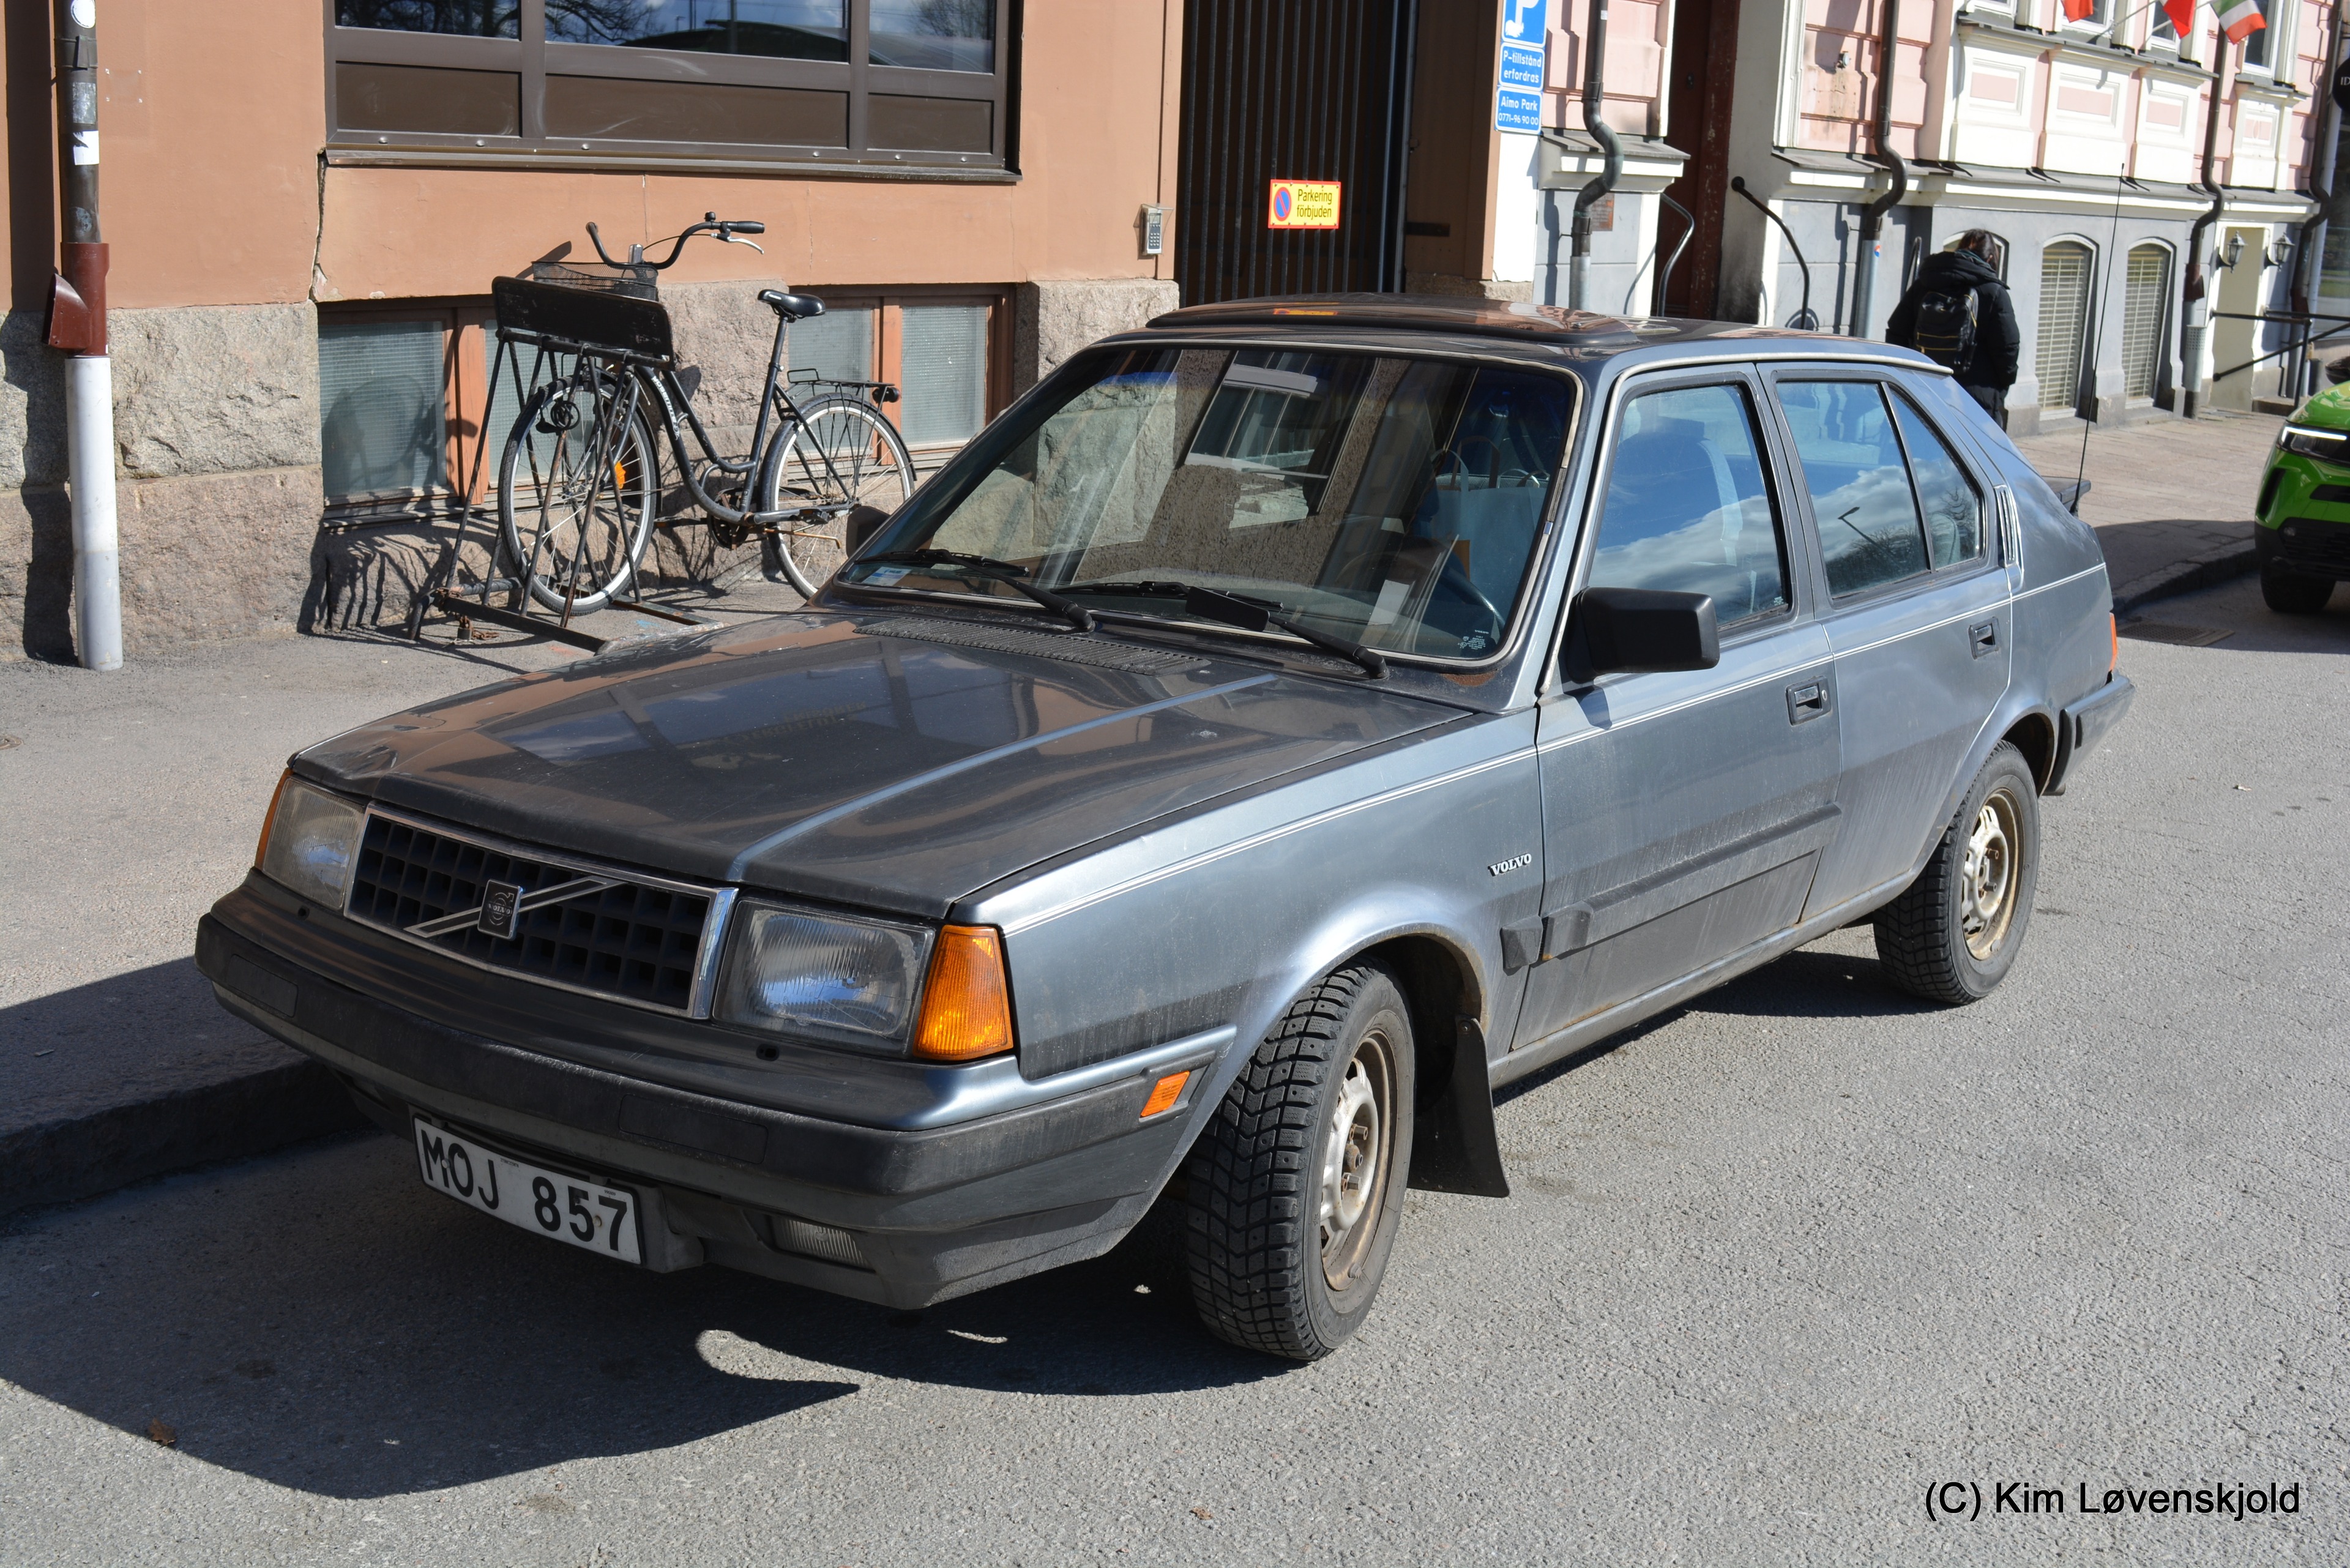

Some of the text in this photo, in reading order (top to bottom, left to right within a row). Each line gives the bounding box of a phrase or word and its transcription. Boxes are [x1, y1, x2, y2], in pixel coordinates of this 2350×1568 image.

[1503, 50, 1542, 67] P-tillstånd
[1504, 69, 1540, 83] erfordras
[1501, 96, 1538, 111] Aimo Park
[1498, 114, 1539, 126] 0771-96 90 00
[1297, 189, 1332, 204] Parkering
[1297, 204, 1332, 220] förbjuden
[1491, 853, 1532, 875] VOLVO
[488, 903, 511, 914] VOLVO
[422, 1129, 628, 1252] MOJ 857
